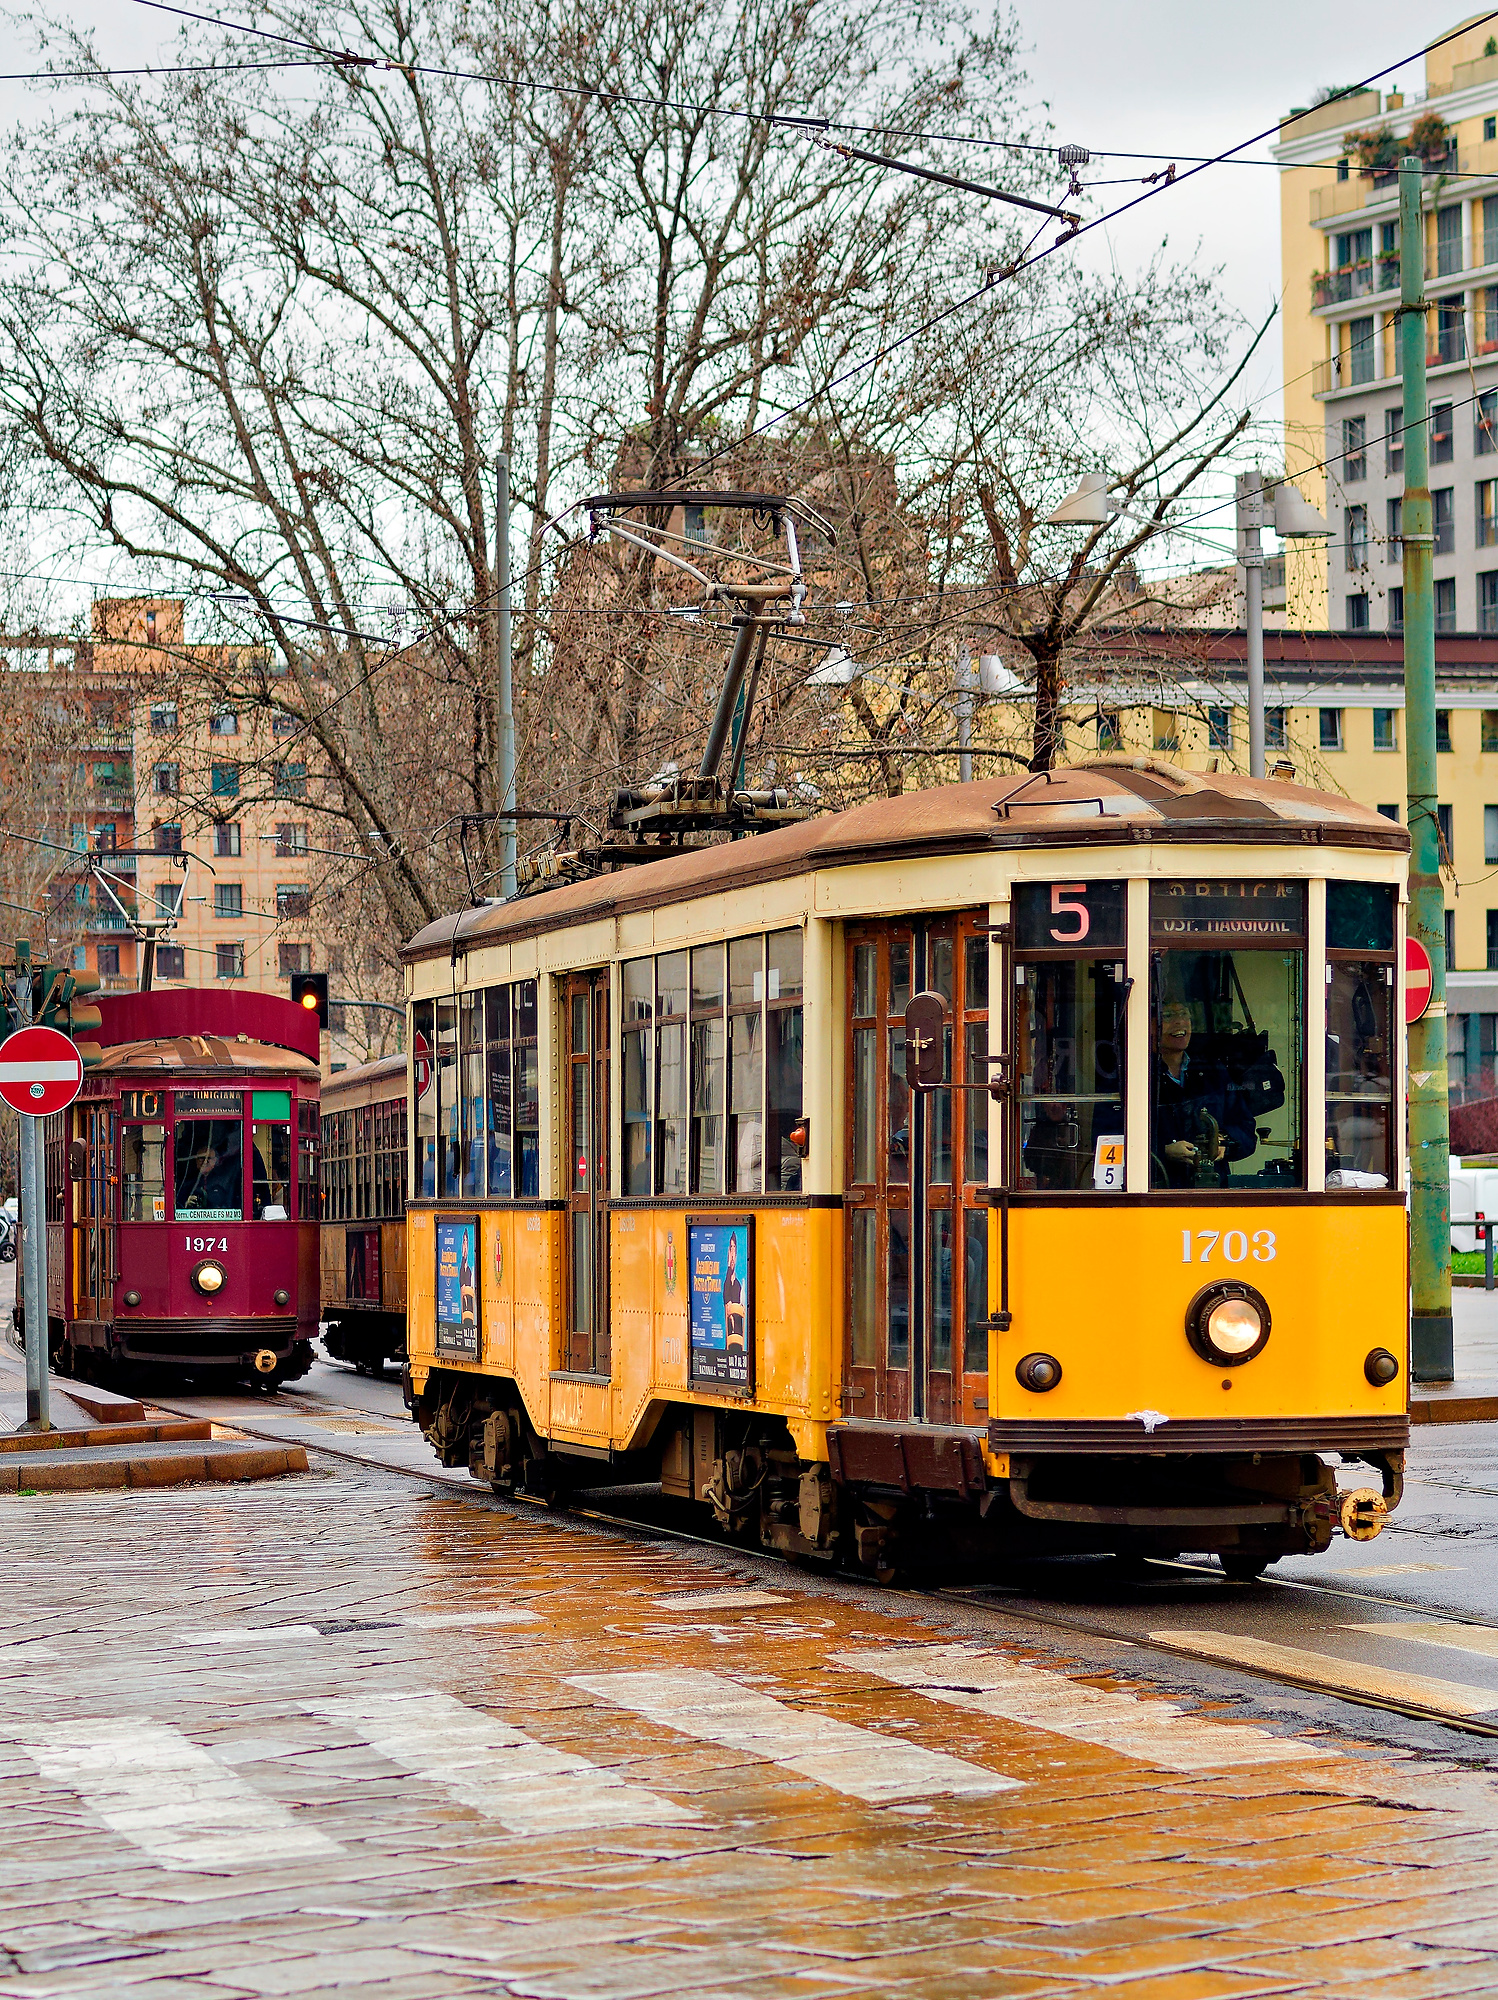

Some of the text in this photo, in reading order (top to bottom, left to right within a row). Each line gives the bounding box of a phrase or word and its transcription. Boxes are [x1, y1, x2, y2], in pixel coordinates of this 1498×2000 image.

[1049, 883, 1090, 942] 5
[131, 1091, 158, 1117] 10
[1105, 1146, 1116, 1163] 4
[1104, 1167, 1115, 1185] 5
[157, 1202, 161, 1210] 1
[189, 1210, 217, 1219] CENTRALE
[217, 1210, 225, 1219] FS
[226, 1210, 233, 1219] M2
[233, 1210, 242, 1219] M3
[156, 1211, 165, 1219] 10
[185, 1236, 228, 1252] 1974
[1181, 1229, 1277, 1263] 1703
[661, 1337, 681, 1365] 1703
